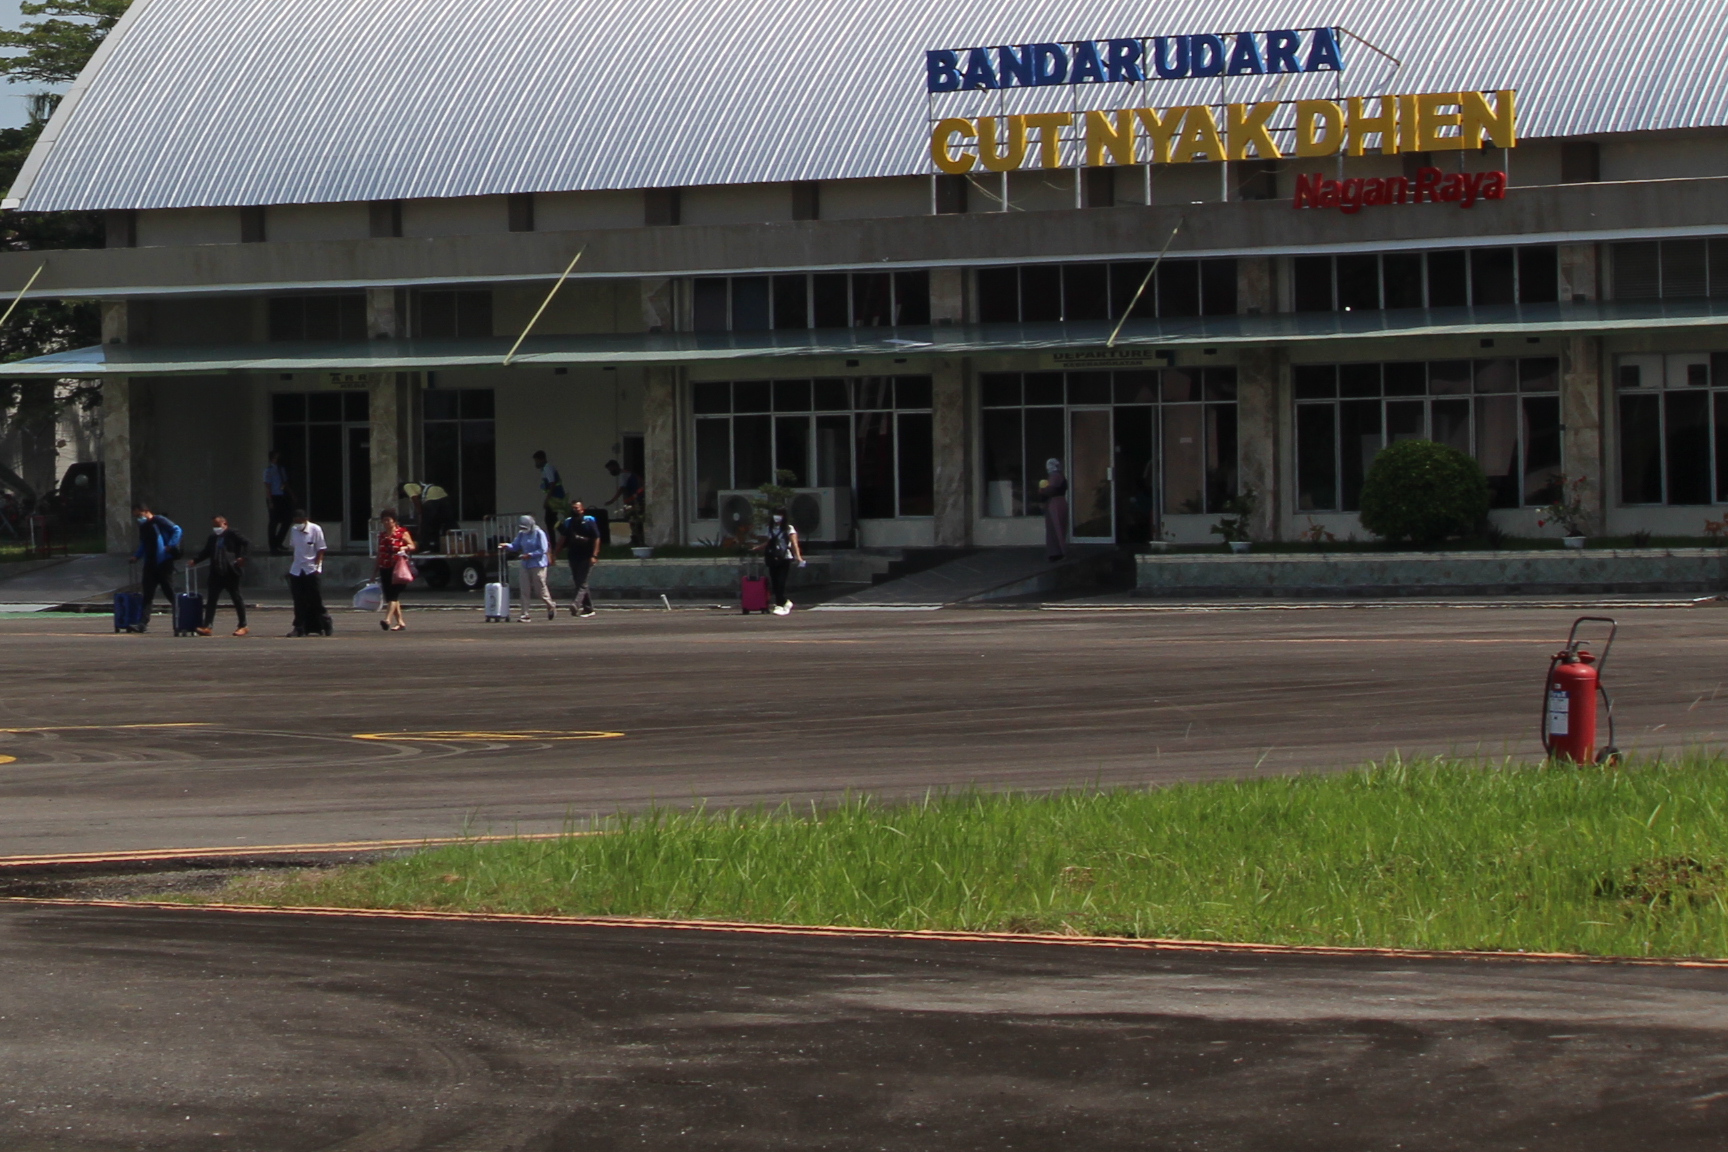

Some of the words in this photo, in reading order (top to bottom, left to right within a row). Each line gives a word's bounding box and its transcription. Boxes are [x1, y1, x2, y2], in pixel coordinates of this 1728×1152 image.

[927, 38, 1145, 93] BANDAR
[1154, 26, 1344, 80] UDARA
[930, 111, 1073, 175] CUT
[1085, 101, 1282, 167] NYAK
[1296, 89, 1516, 158] DHIEN
[1293, 172, 1408, 214] Nagan
[1413, 166, 1506, 209] Raya
[1053, 349, 1153, 360] DEPARTURE
